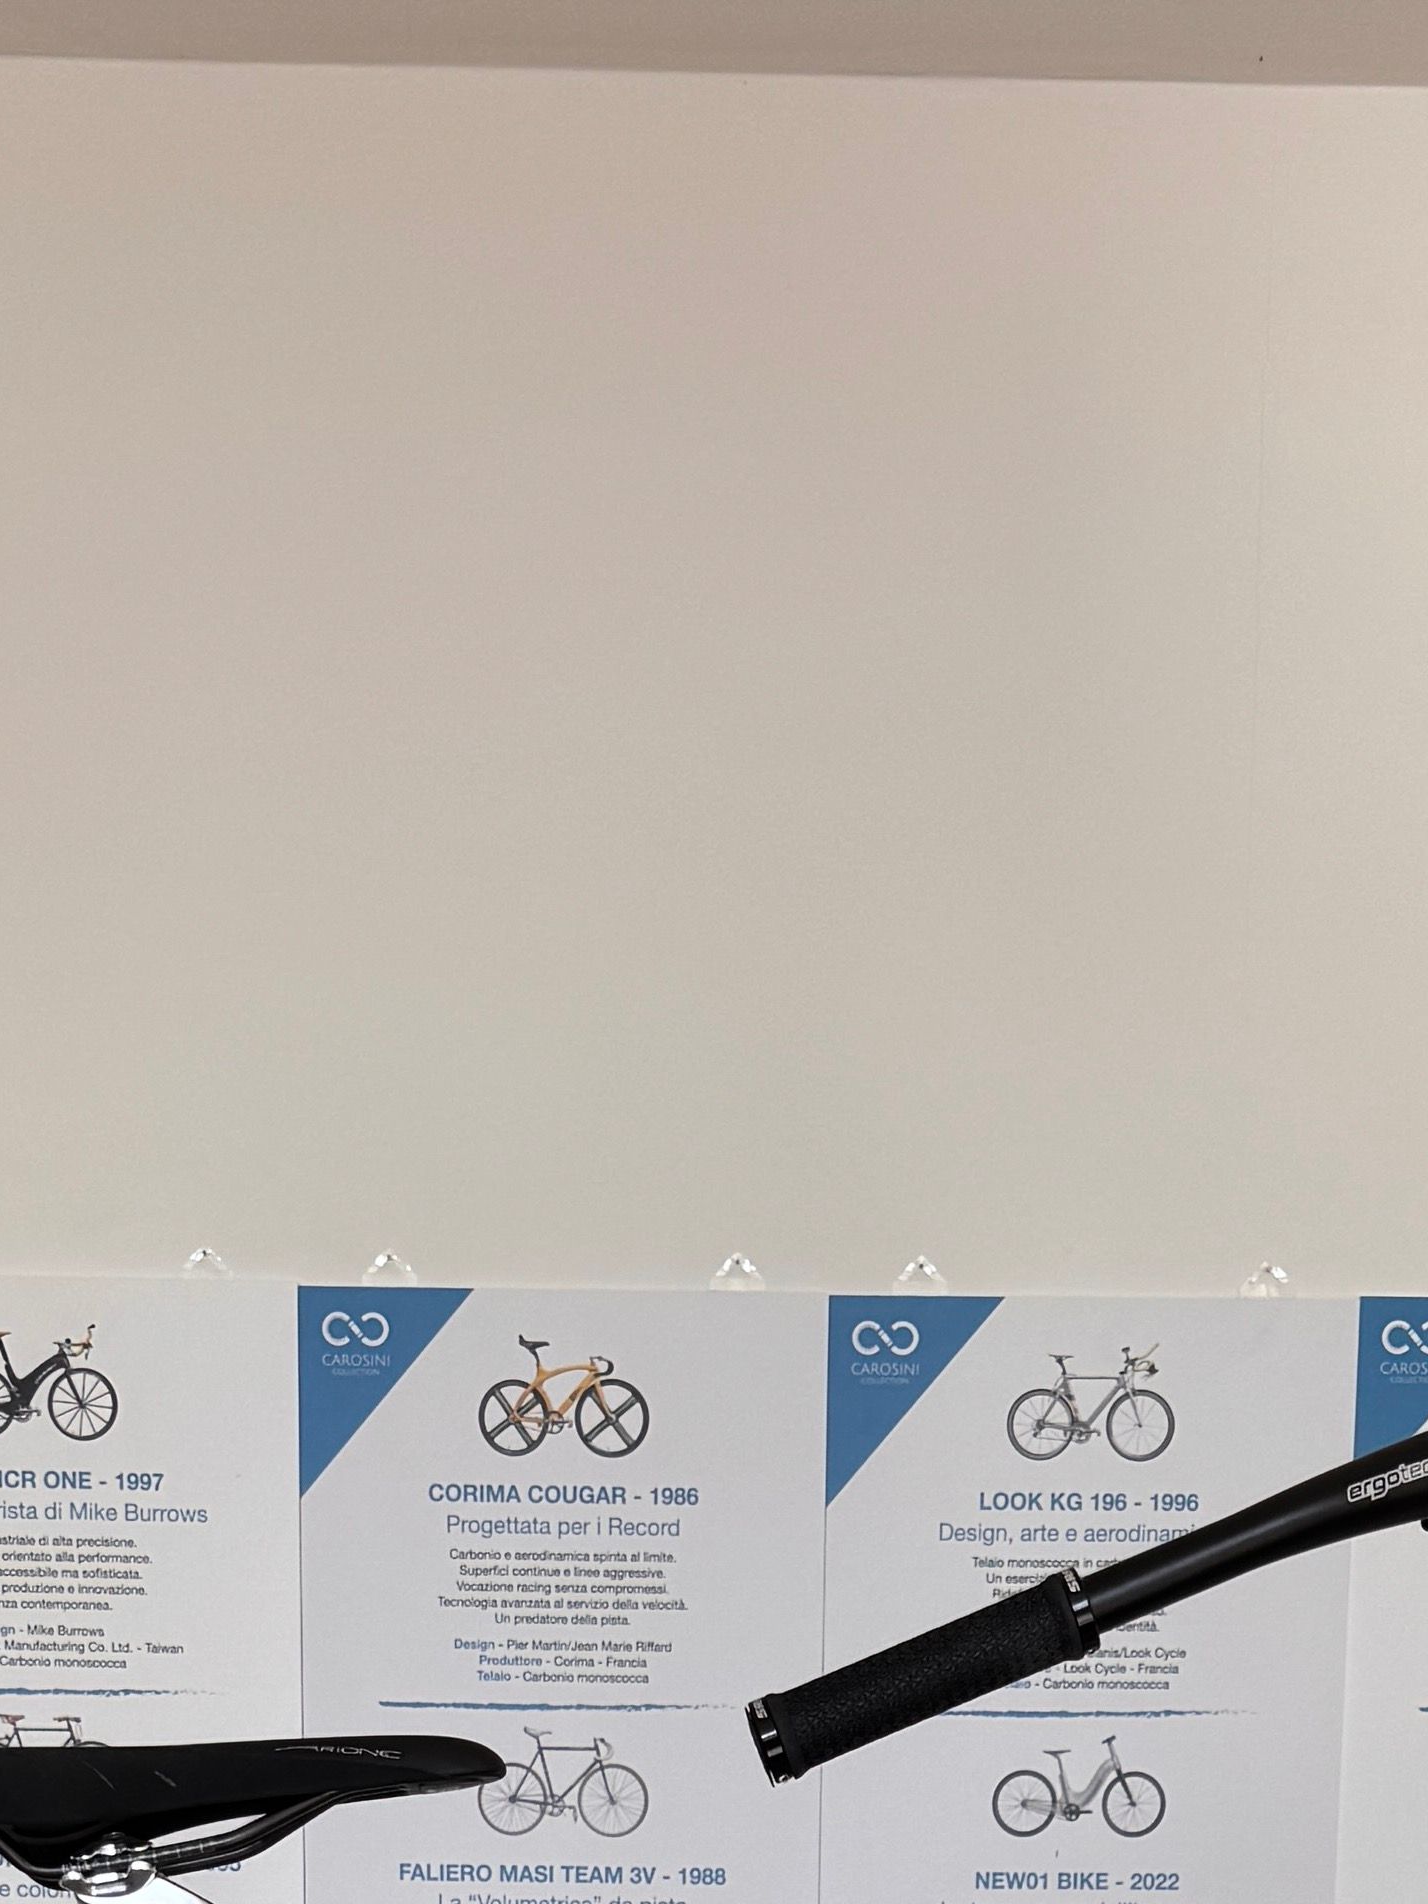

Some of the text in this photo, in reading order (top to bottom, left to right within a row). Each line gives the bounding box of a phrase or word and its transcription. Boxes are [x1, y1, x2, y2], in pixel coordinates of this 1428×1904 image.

[850, 1362, 920, 1377] CAROSINI
[43, 1470, 93, 1490] ONE
[115, 1472, 164, 1492] 1997
[428, 1483, 699, 1506] CORIMA COUGAR 1986
[979, 1491, 1199, 1512] LOOK KG 196 1996
[446, 1514, 681, 1540] Progettata per i Record
[399, 1862, 727, 1886] FALIERO MASI TEAM 3V 1988
[975, 1871, 1180, 1891] NEW01 BIKE 2022
